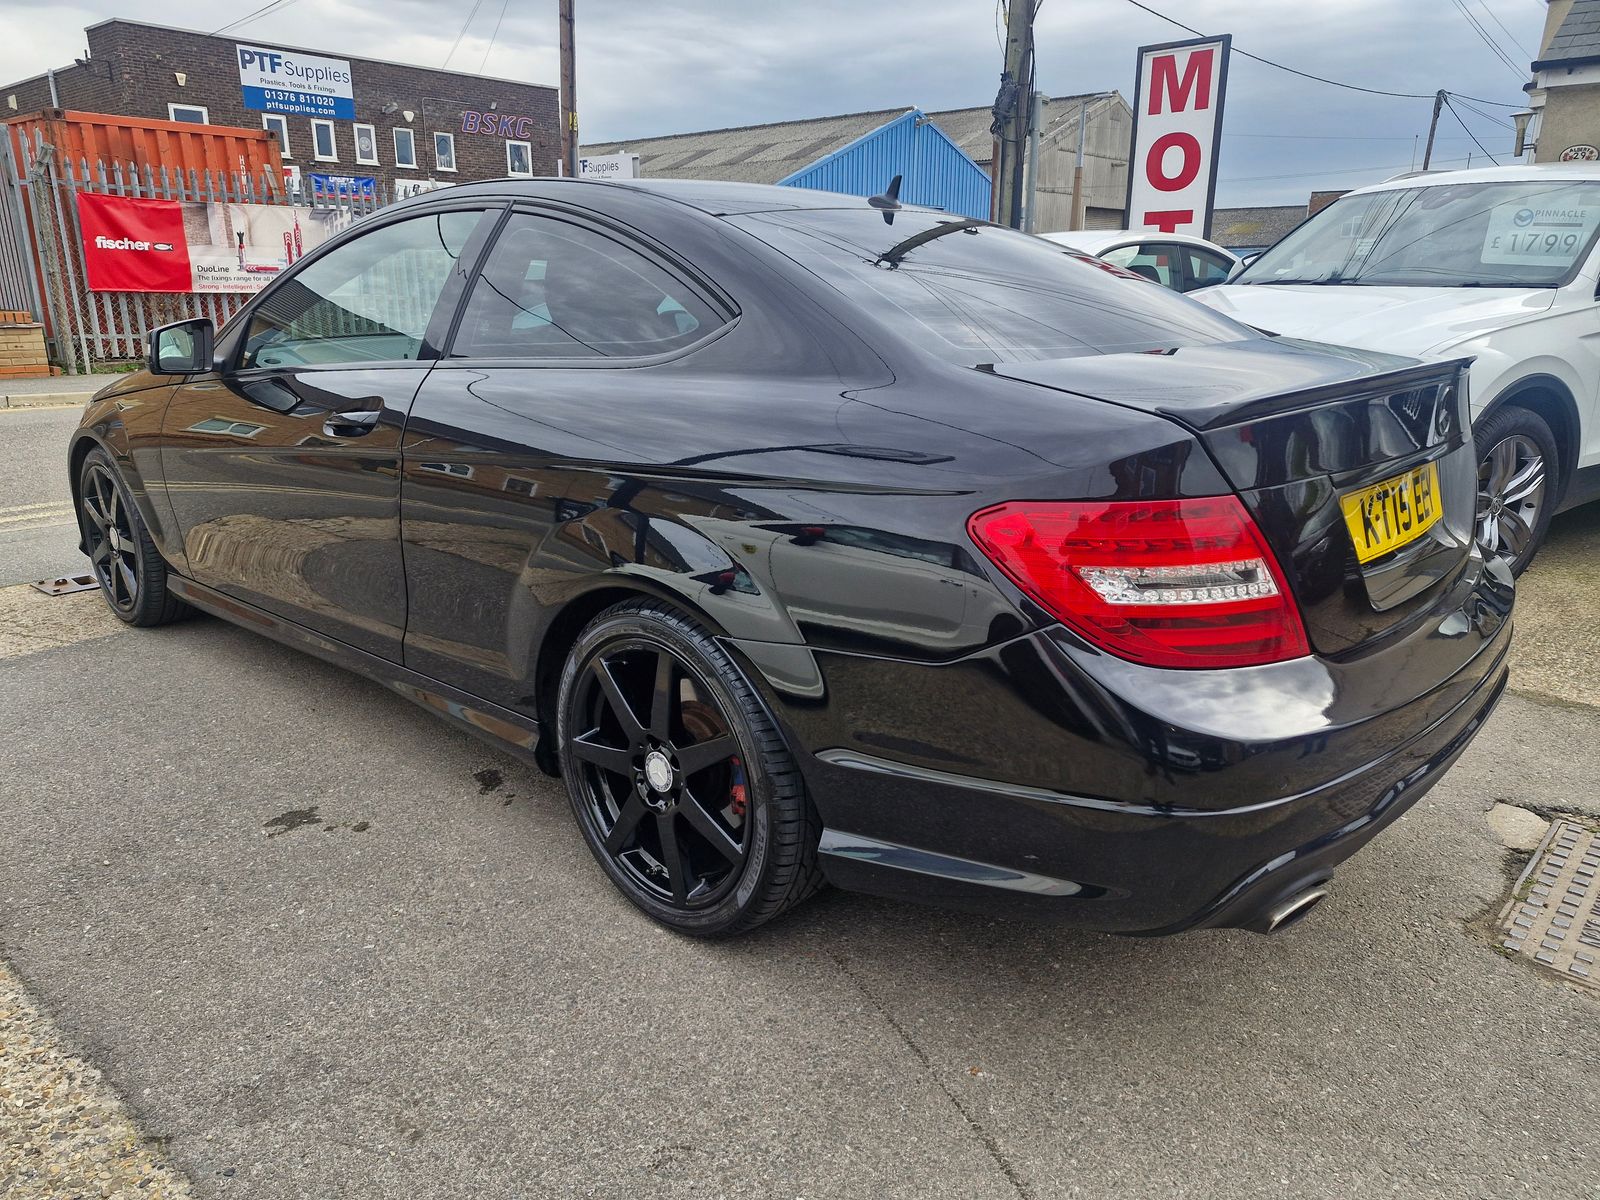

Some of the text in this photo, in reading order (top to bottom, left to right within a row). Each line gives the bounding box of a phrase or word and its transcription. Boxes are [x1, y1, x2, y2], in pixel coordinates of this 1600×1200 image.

[239, 48, 350, 84] PTF Supplies
[260, 77, 287, 87] Plastics,
[289, 81, 306, 90] Tools
[313, 84, 336, 94] Fixings
[264, 89, 335, 107] 01376 811020
[266, 101, 336, 116] ptfsupplies.com
[461, 110, 533, 139] BSKC
[1573, 151, 1587, 160] 29
[588, 161, 620, 174] Supplies
[1534, 208, 1587, 218] PINNACLE
[95, 235, 150, 251] fischer
[197, 264, 230, 273] DuoLine
[211, 274, 232, 282] fixings
[252, 274, 262, 282] for
[199, 283, 220, 291] Strong
